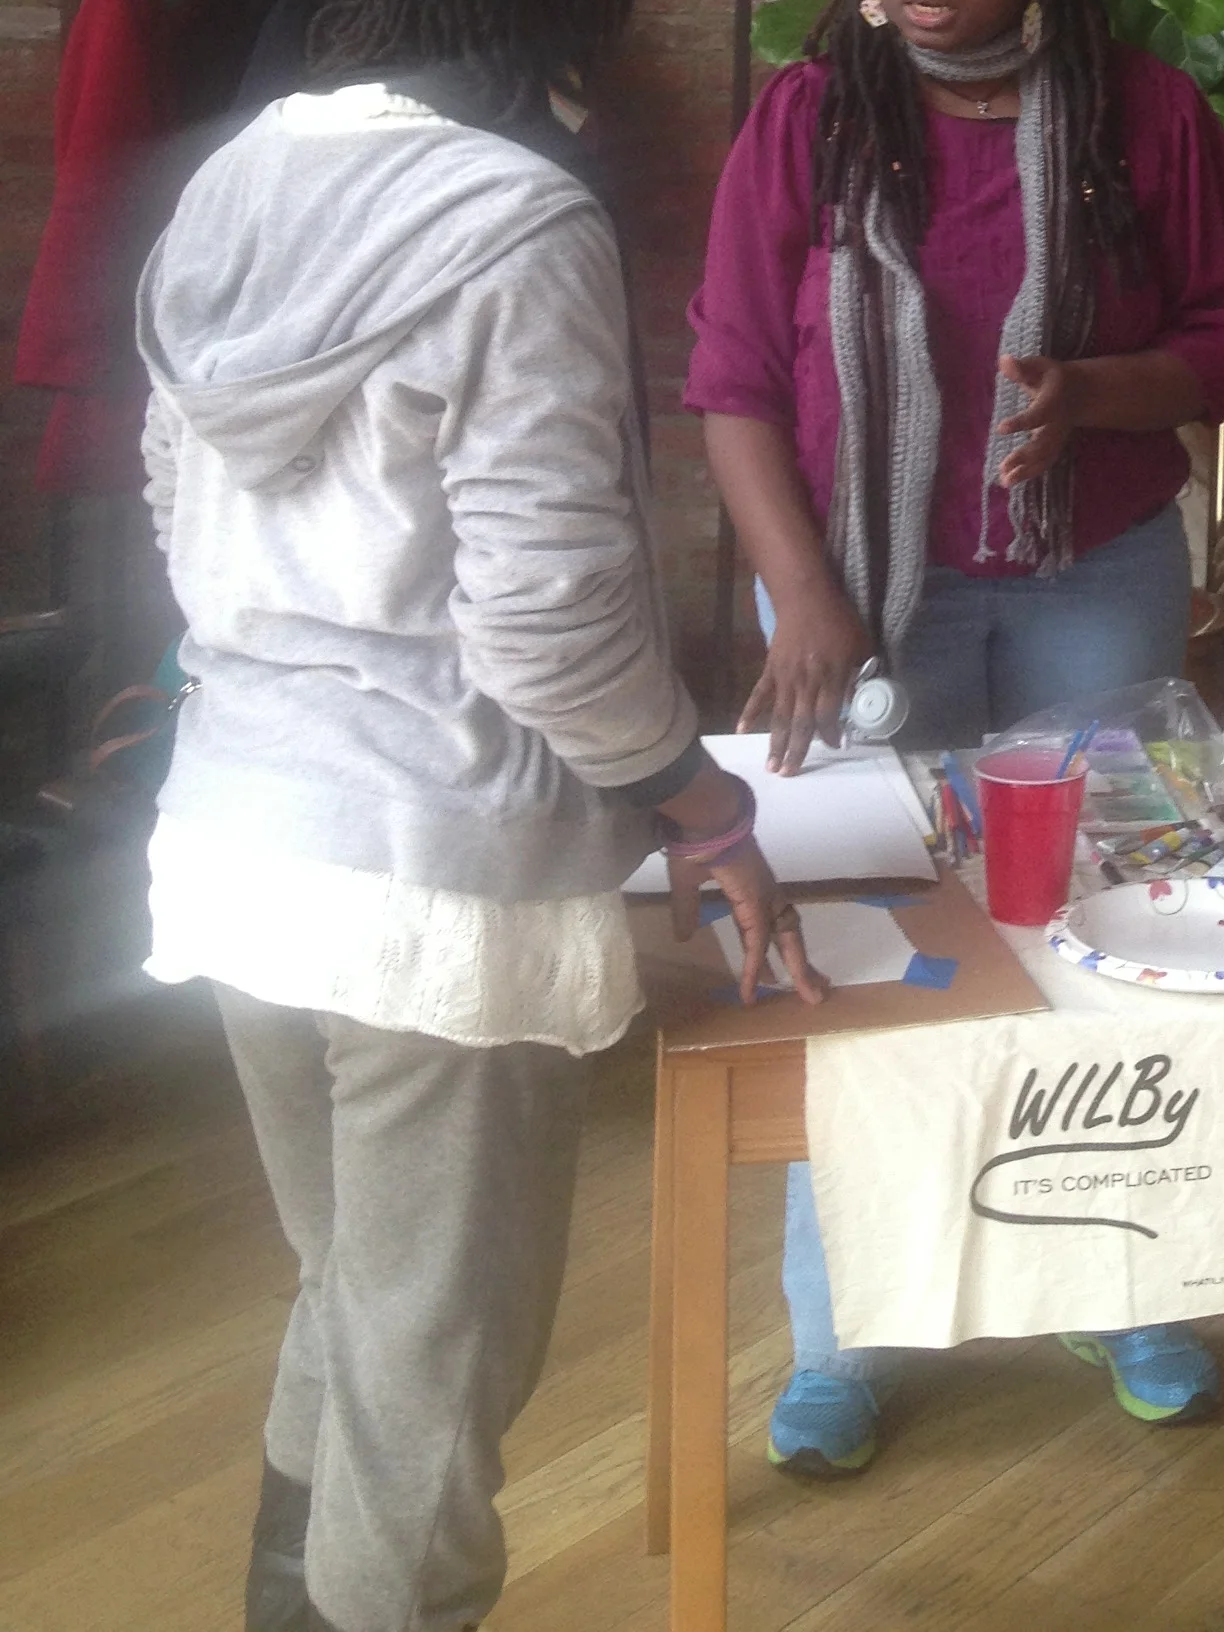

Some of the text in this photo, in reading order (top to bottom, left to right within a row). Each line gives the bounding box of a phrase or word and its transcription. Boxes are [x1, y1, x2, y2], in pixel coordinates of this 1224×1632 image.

[1008, 1053, 1199, 1146] WILBy
[1013, 1164, 1212, 1196] IT'S COMPLICATED
